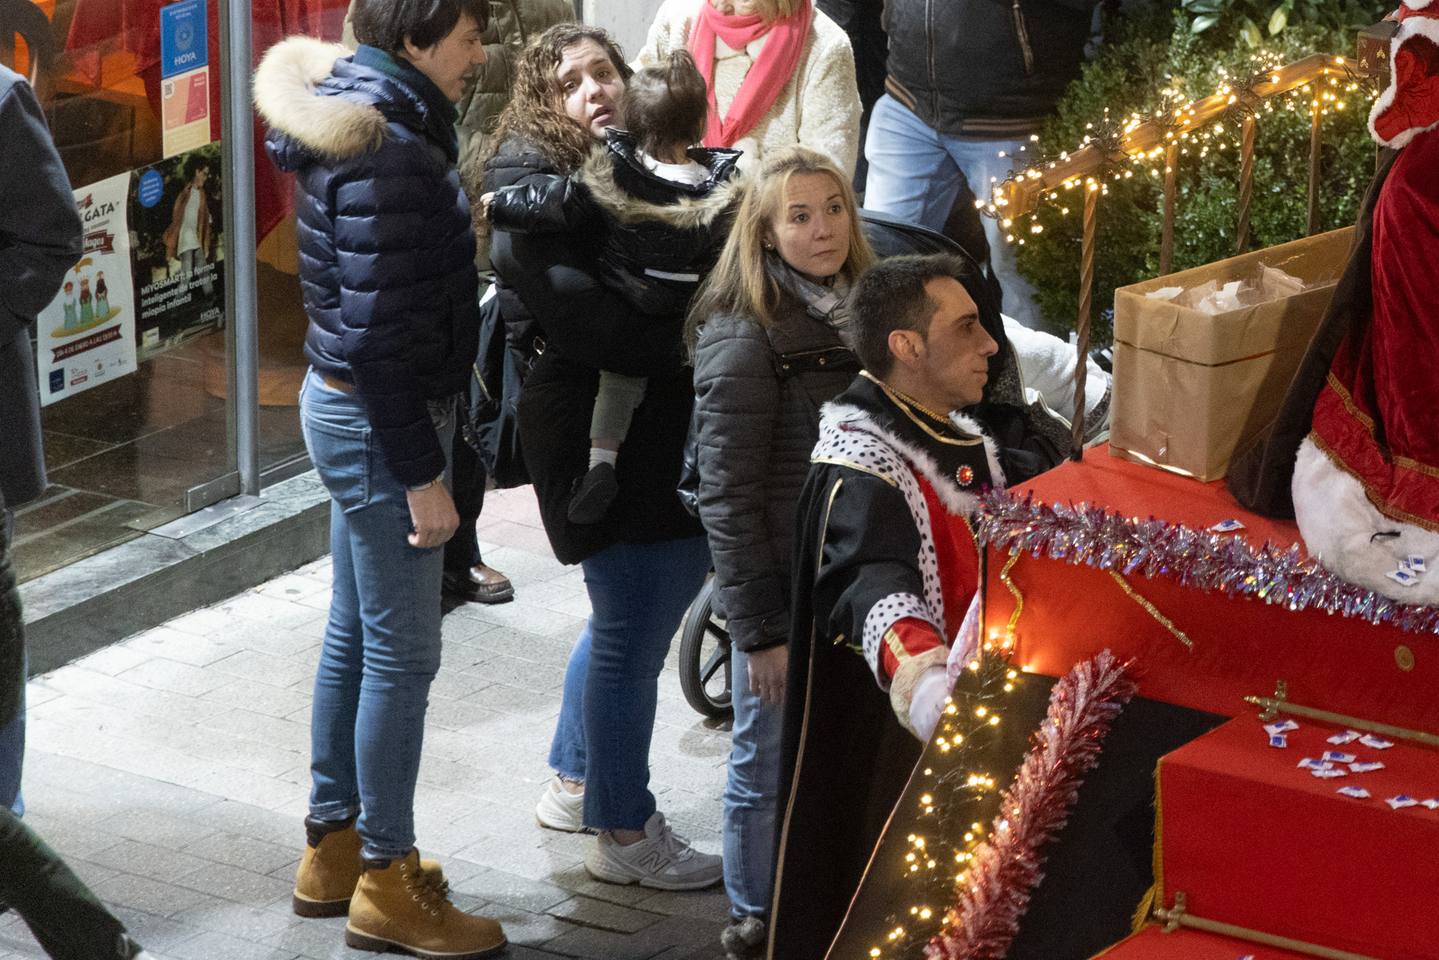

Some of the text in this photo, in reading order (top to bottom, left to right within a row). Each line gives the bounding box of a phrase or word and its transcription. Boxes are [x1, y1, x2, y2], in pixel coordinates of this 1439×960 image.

[174, 51, 198, 66] HOYA
[193, 261, 215, 277] forma
[165, 293, 192, 311] infantil
[200, 306, 220, 319] HOYA
